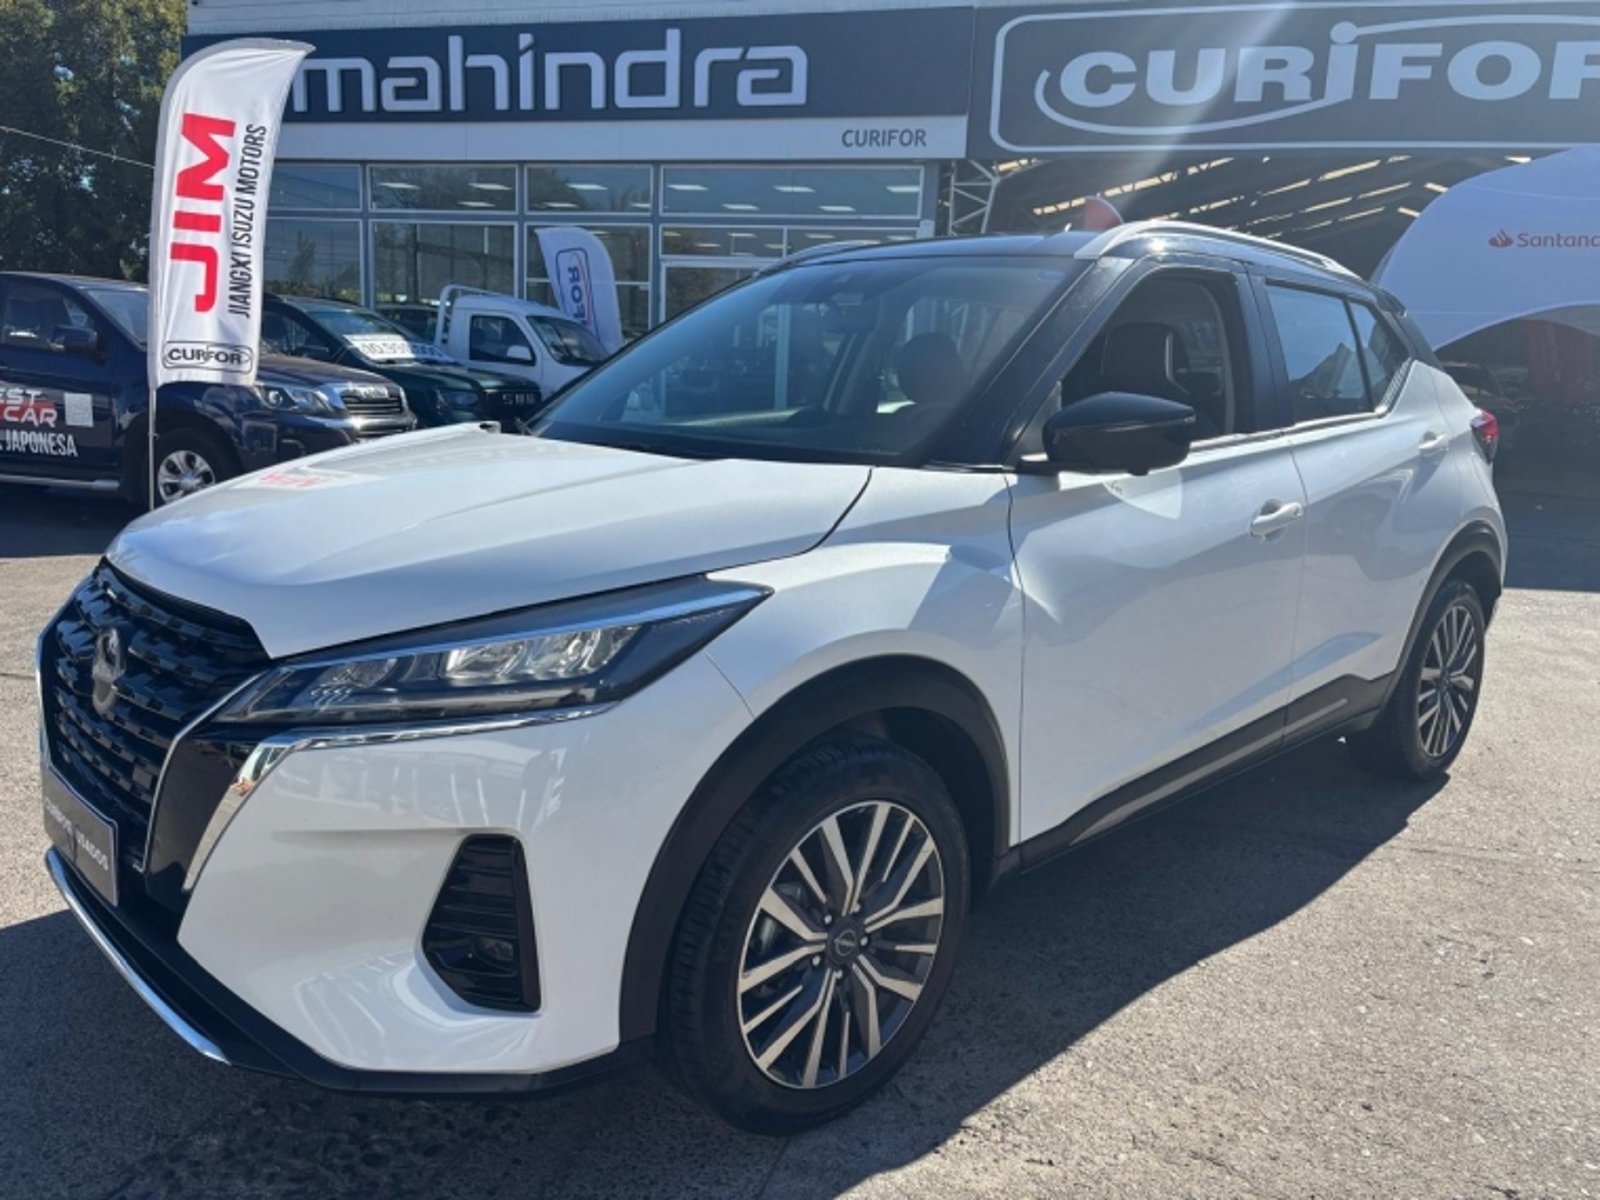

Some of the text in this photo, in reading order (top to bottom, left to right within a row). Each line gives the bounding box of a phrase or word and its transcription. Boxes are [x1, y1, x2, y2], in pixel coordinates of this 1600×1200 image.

[293, 29, 807, 112] mahindra
[841, 128, 928, 148] CURIFOR
[170, 113, 236, 313] JIM
[228, 124, 267, 319] JIANGXI ISUZU MOTORS
[4, 404, 58, 428] CAR
[6, 429, 78, 457] JAPONESA
